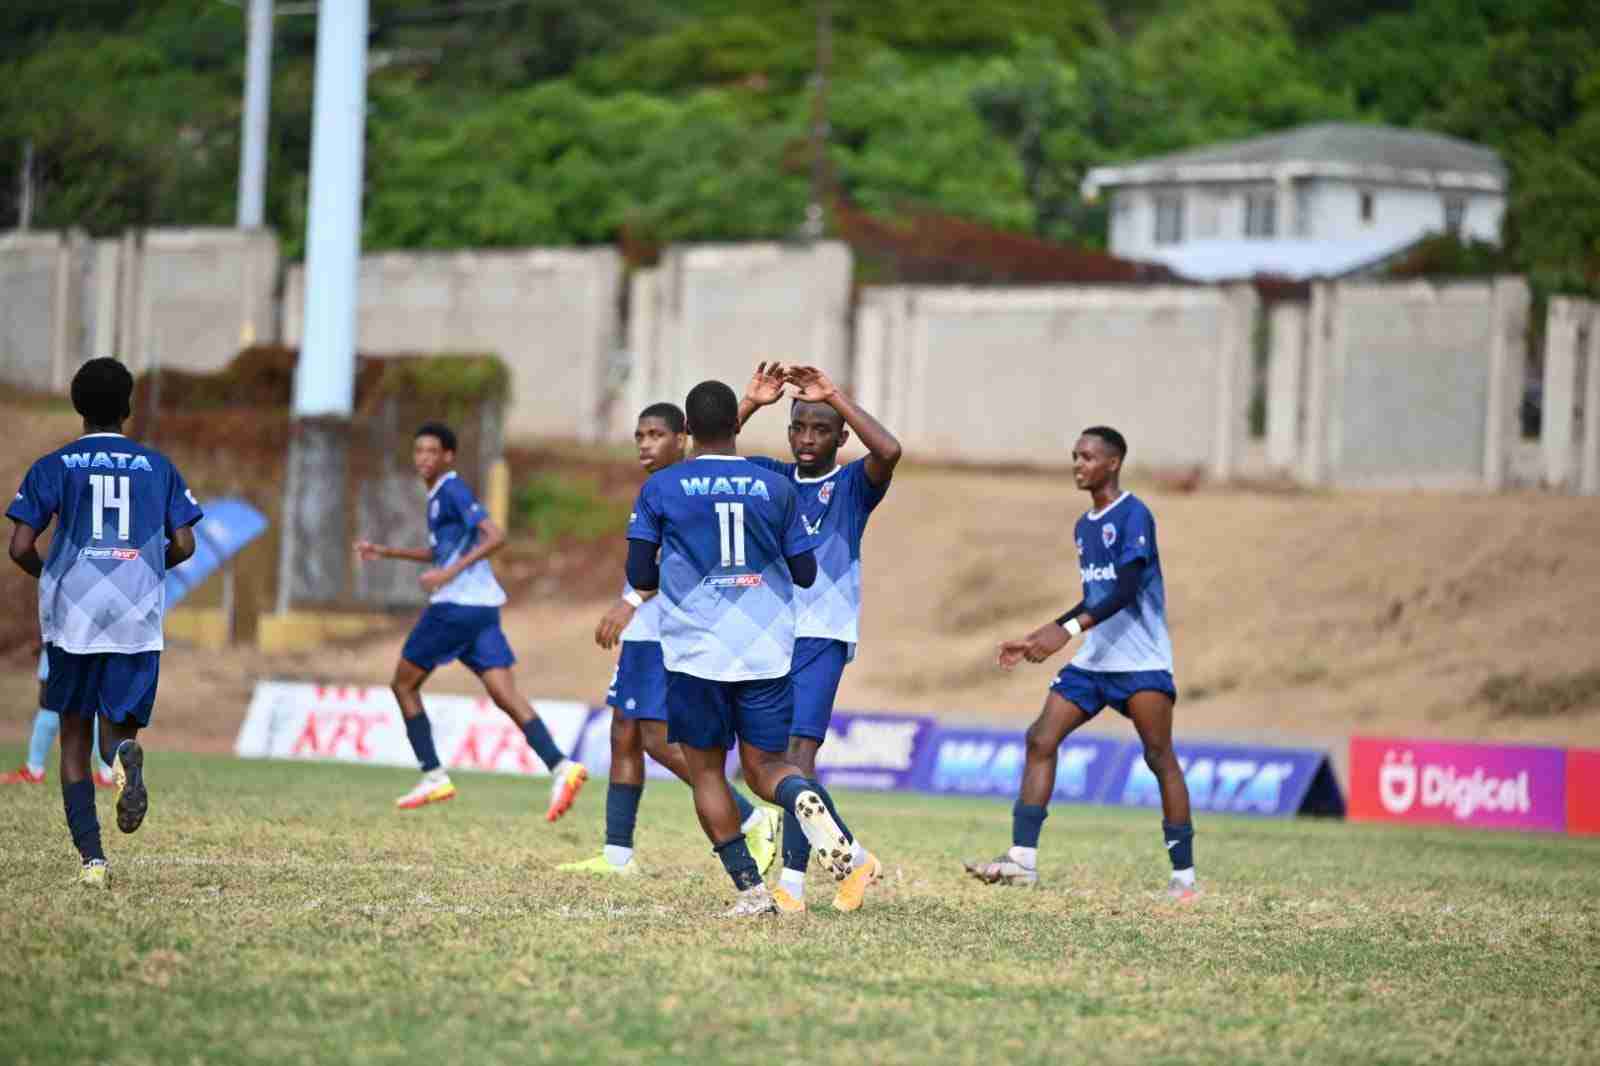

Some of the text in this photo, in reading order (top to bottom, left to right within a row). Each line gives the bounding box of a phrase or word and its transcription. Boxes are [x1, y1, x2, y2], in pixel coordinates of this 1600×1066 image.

[61, 452, 152, 471] WATA
[680, 476, 769, 501] WATA
[89, 474, 130, 540] 14
[715, 502, 745, 567] 11
[1421, 764, 1530, 820] Digicel
